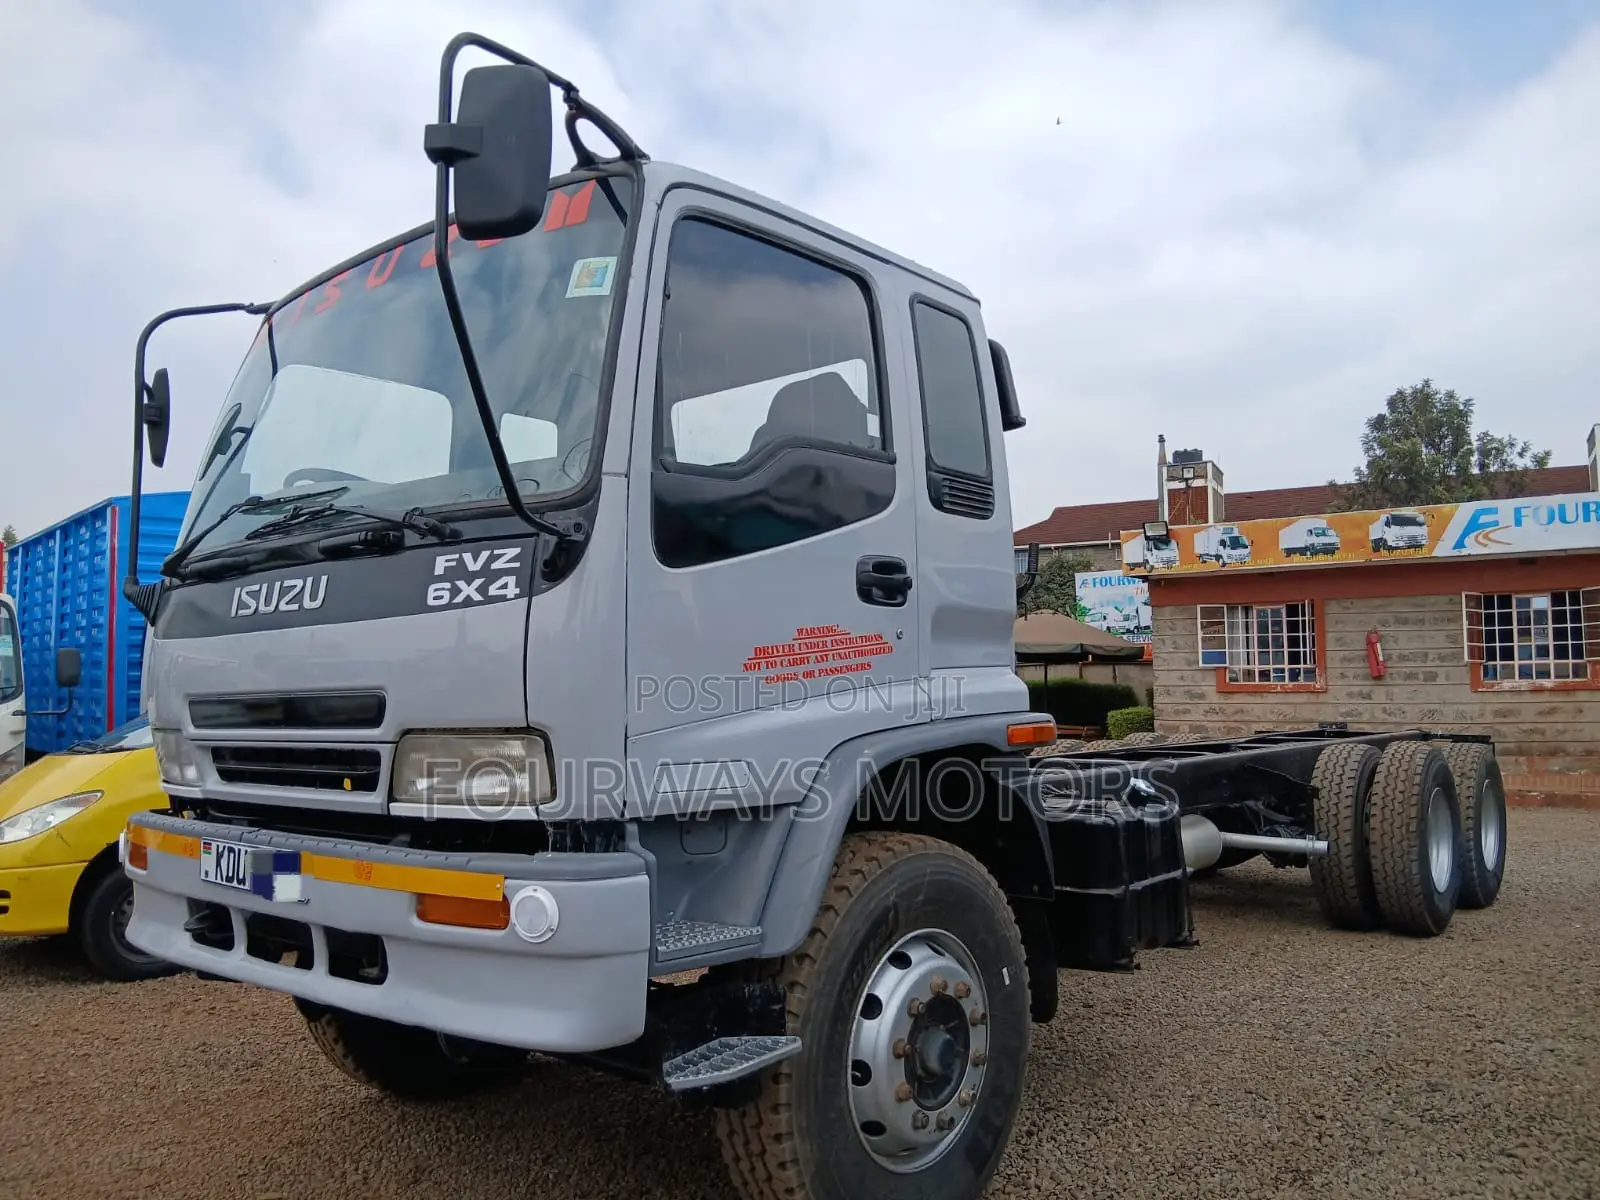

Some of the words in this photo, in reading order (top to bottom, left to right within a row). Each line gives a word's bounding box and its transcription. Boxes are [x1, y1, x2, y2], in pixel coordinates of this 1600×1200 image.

[434, 547, 522, 576] FVZ
[230, 575, 329, 618] ISUZU
[427, 576, 520, 606] 6X4
[743, 661, 762, 672] NOT
[765, 659, 778, 669] TO
[780, 656, 811, 667] CARRY
[813, 653, 830, 664] ANY
[832, 646, 893, 660] UNAUTHORIZED
[754, 643, 795, 657] DRIVER
[798, 639, 831, 652] UNDER
[765, 672, 799, 684] GOODS
[802, 669, 817, 679] OR
[818, 661, 872, 677] PASSENGERS
